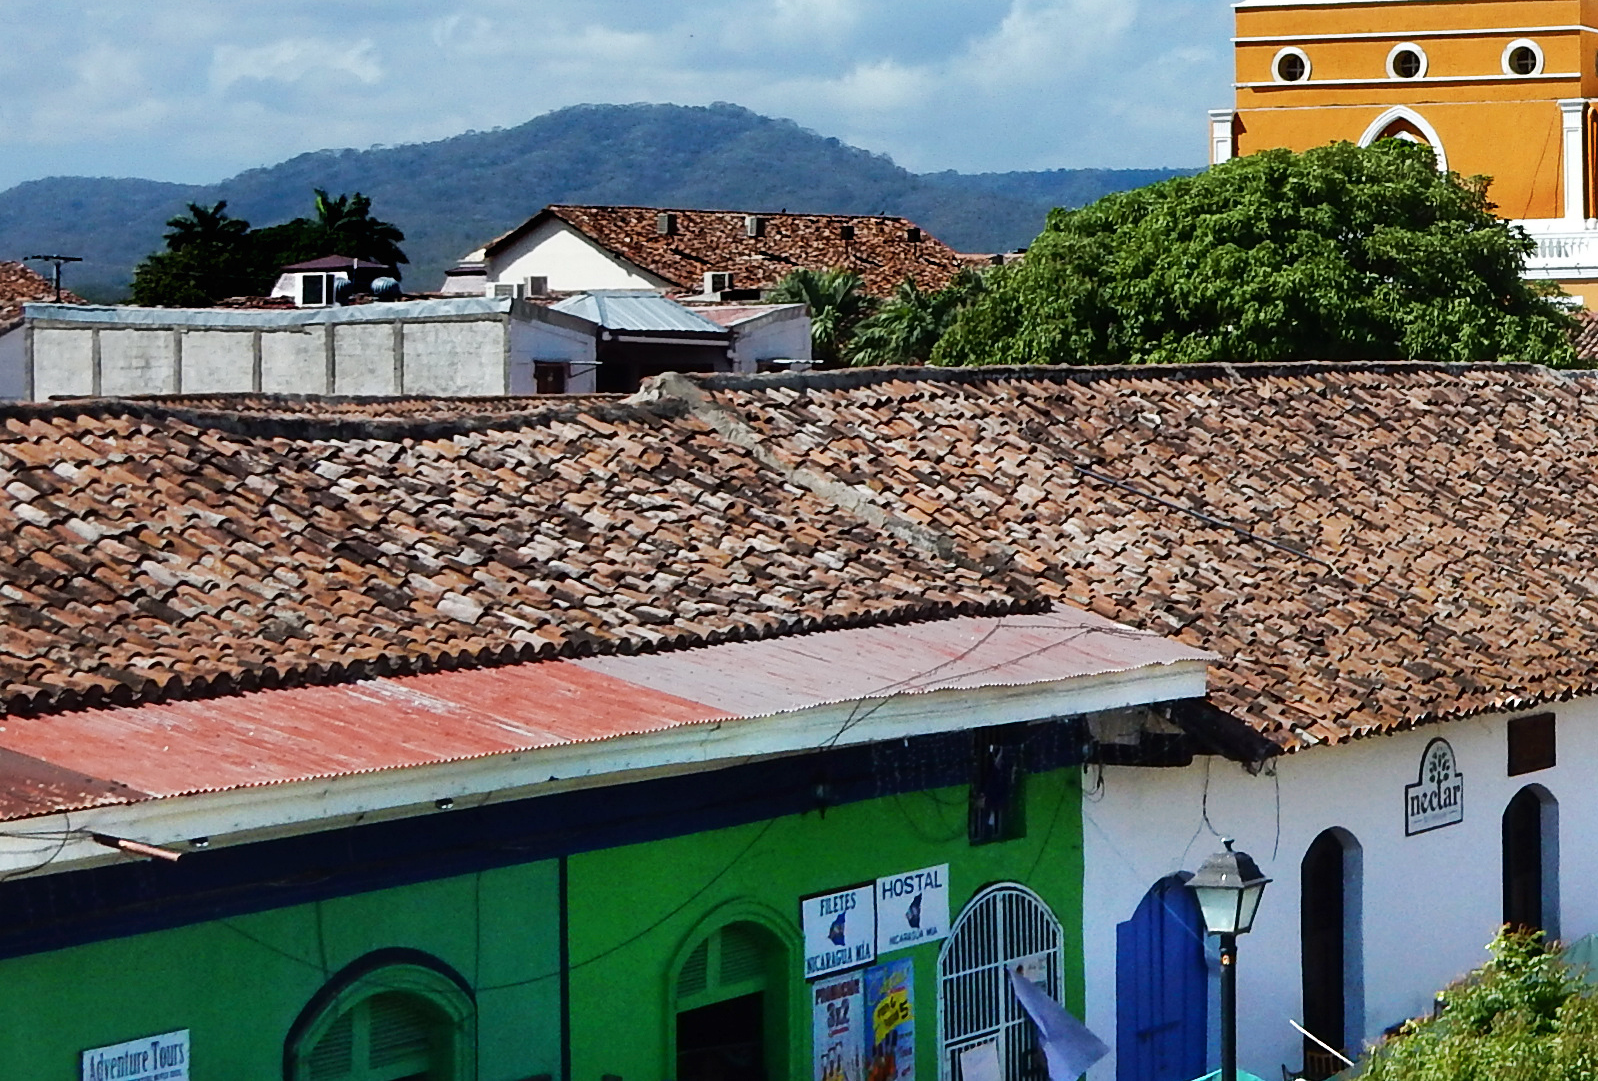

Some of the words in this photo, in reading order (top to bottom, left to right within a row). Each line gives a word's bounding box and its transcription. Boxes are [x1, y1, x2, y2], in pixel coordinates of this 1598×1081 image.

[1410, 780, 1460, 817] nectar
[882, 870, 943, 900] HOSTAL
[820, 891, 857, 917] FILETES
[889, 929, 924, 946] NICARAGUA
[806, 947, 852, 974] NICARAGUA
[89, 1051, 149, 1081] Adventure
[151, 1040, 185, 1070] Tours
